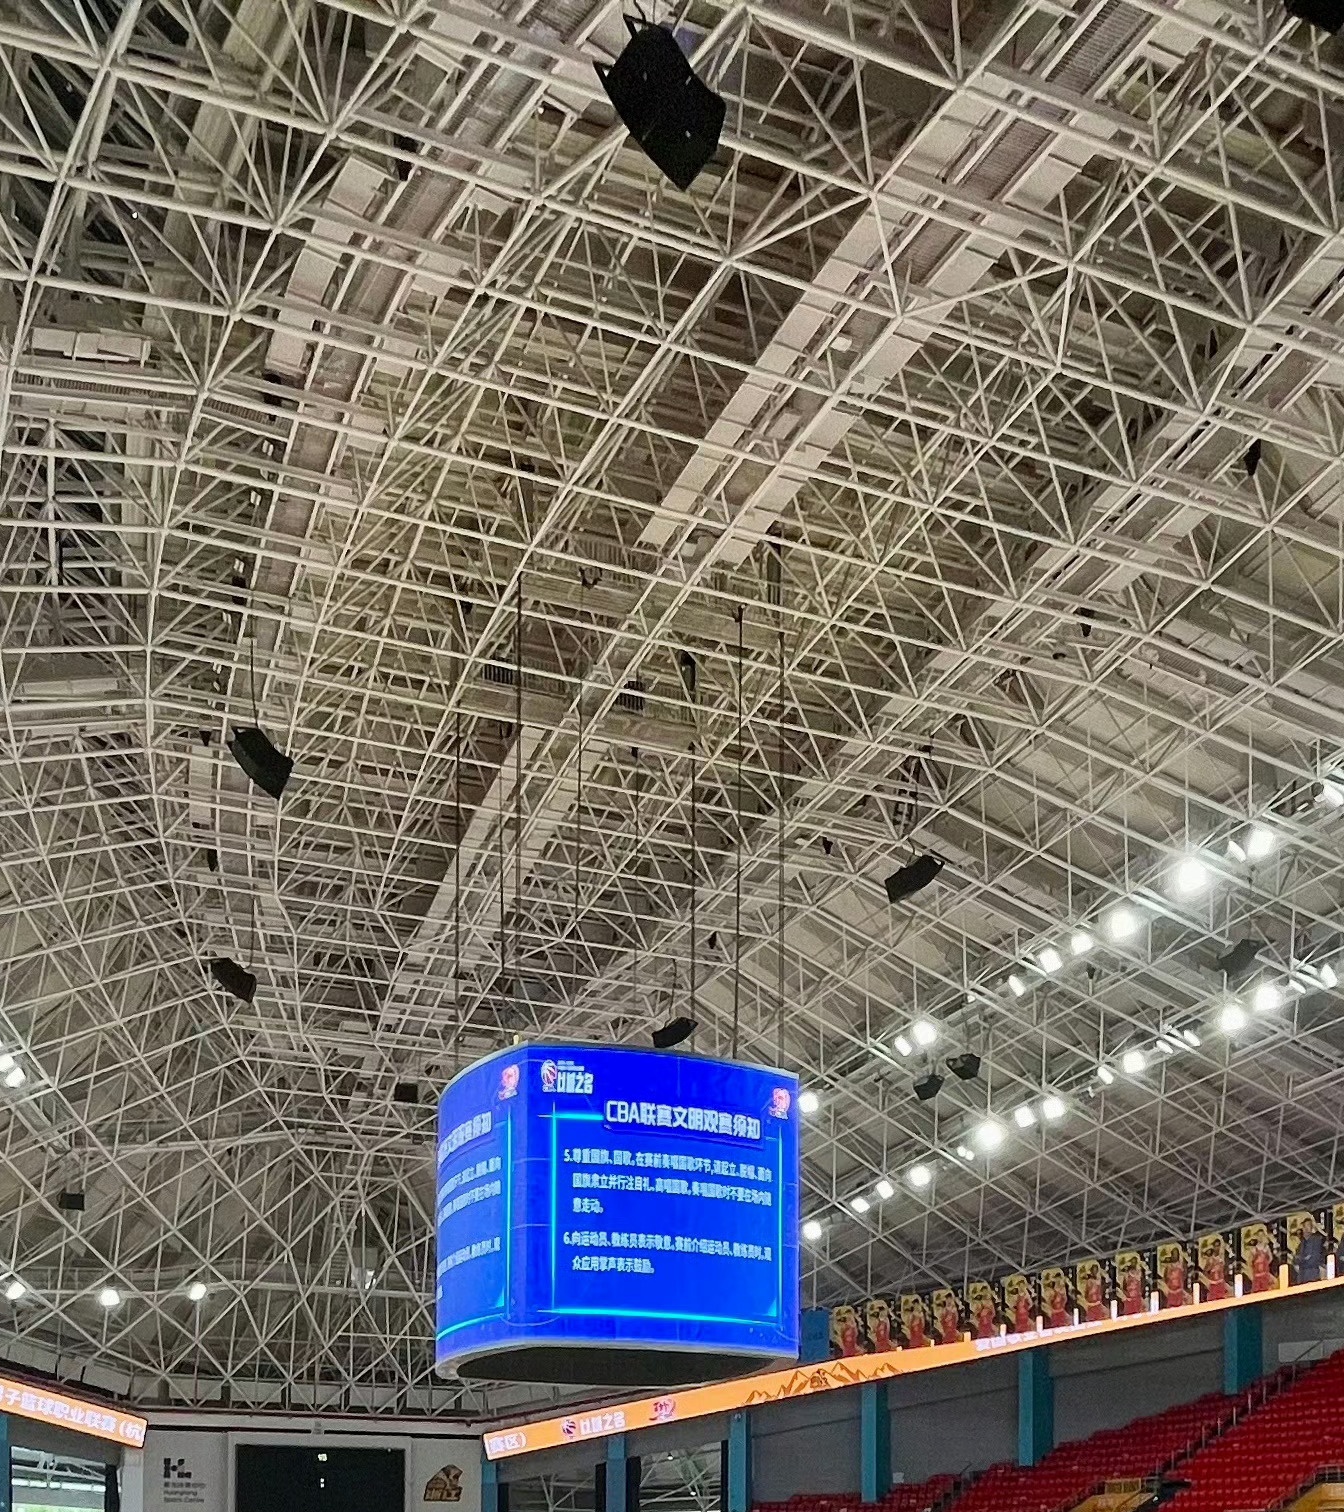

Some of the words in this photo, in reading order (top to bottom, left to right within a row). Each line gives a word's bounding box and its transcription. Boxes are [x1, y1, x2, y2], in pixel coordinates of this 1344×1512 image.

[606, 1100, 761, 1140] CBA联赛文明观赛须知
